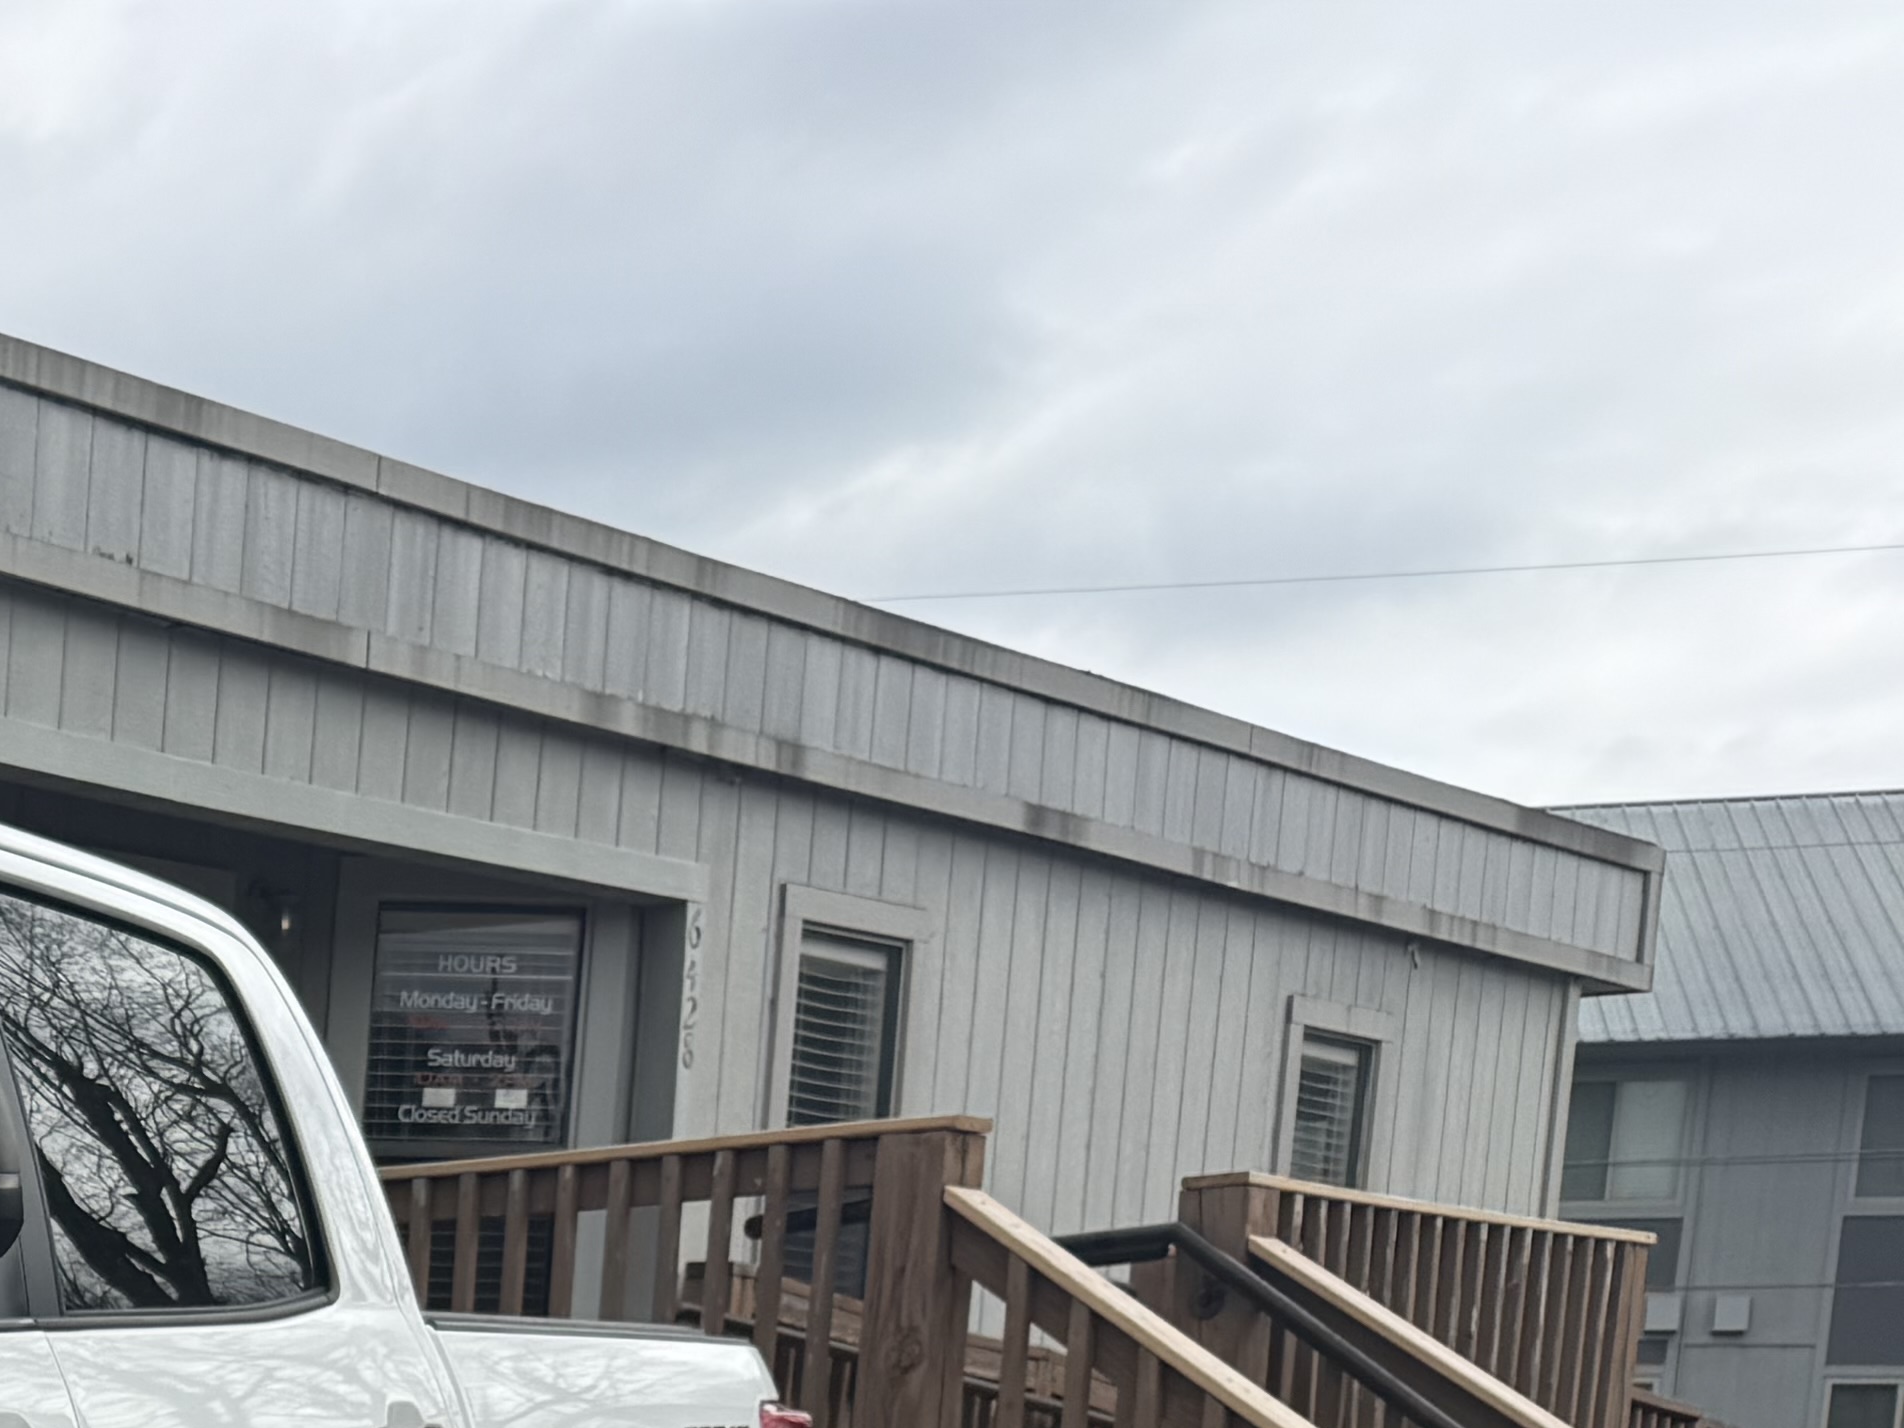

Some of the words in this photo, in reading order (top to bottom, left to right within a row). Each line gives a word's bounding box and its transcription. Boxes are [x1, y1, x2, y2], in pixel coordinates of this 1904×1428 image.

[438, 955, 517, 973] HOURS
[400, 991, 478, 1013] Monday
[491, 994, 553, 1015] Friday
[427, 1049, 516, 1072] Saturday
[398, 1104, 459, 1124] Closed
[463, 1105, 536, 1129] Sunday
